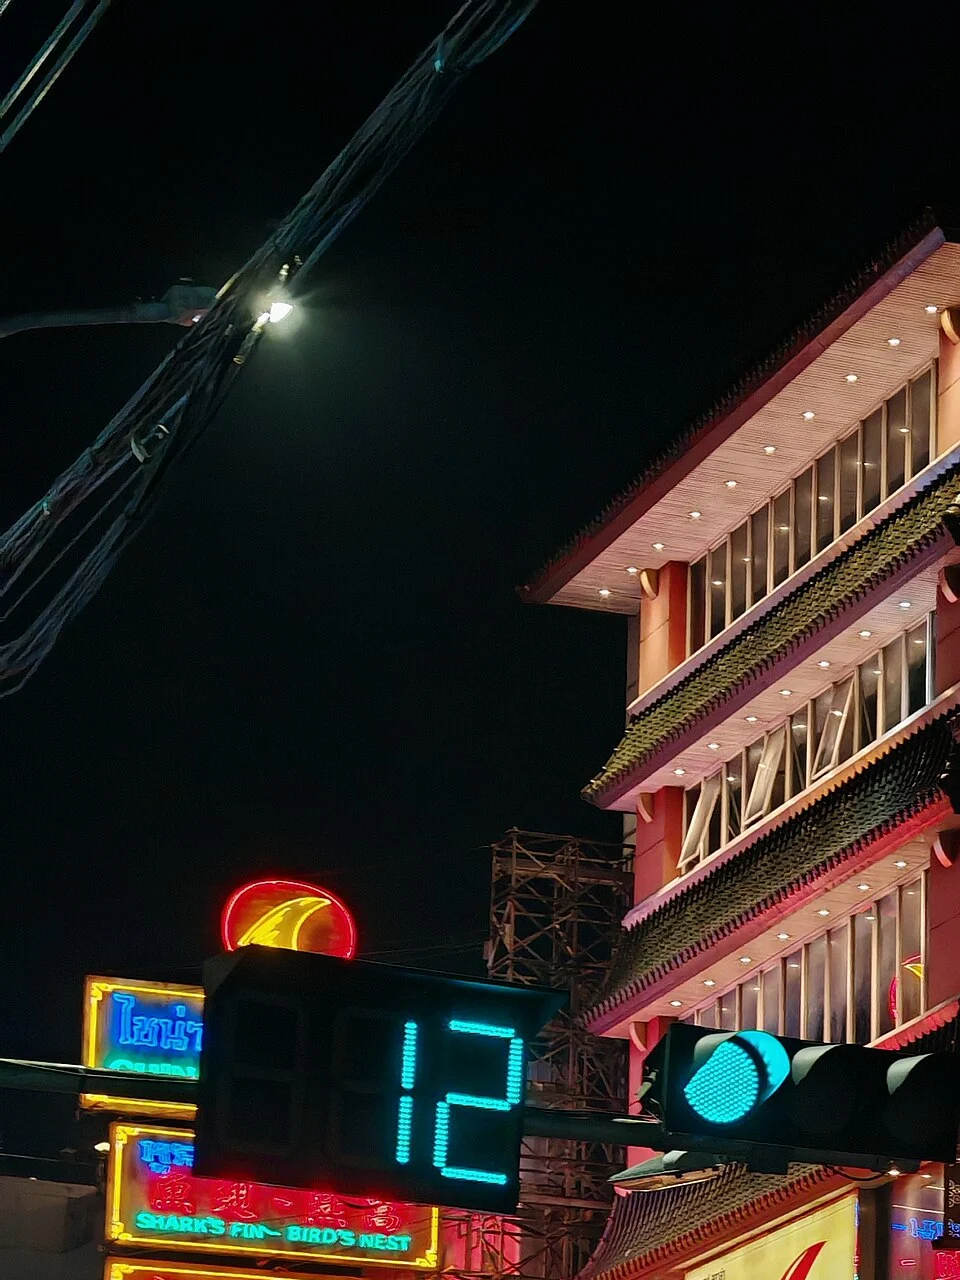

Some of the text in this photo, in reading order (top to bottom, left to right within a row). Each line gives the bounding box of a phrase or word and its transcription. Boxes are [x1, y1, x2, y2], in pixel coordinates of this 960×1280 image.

[396, 1019, 524, 1186] 12
[136, 1212, 226, 1236] SHARK'S
[286, 1224, 356, 1247] BIRD'S
[358, 1233, 412, 1252] NEST
